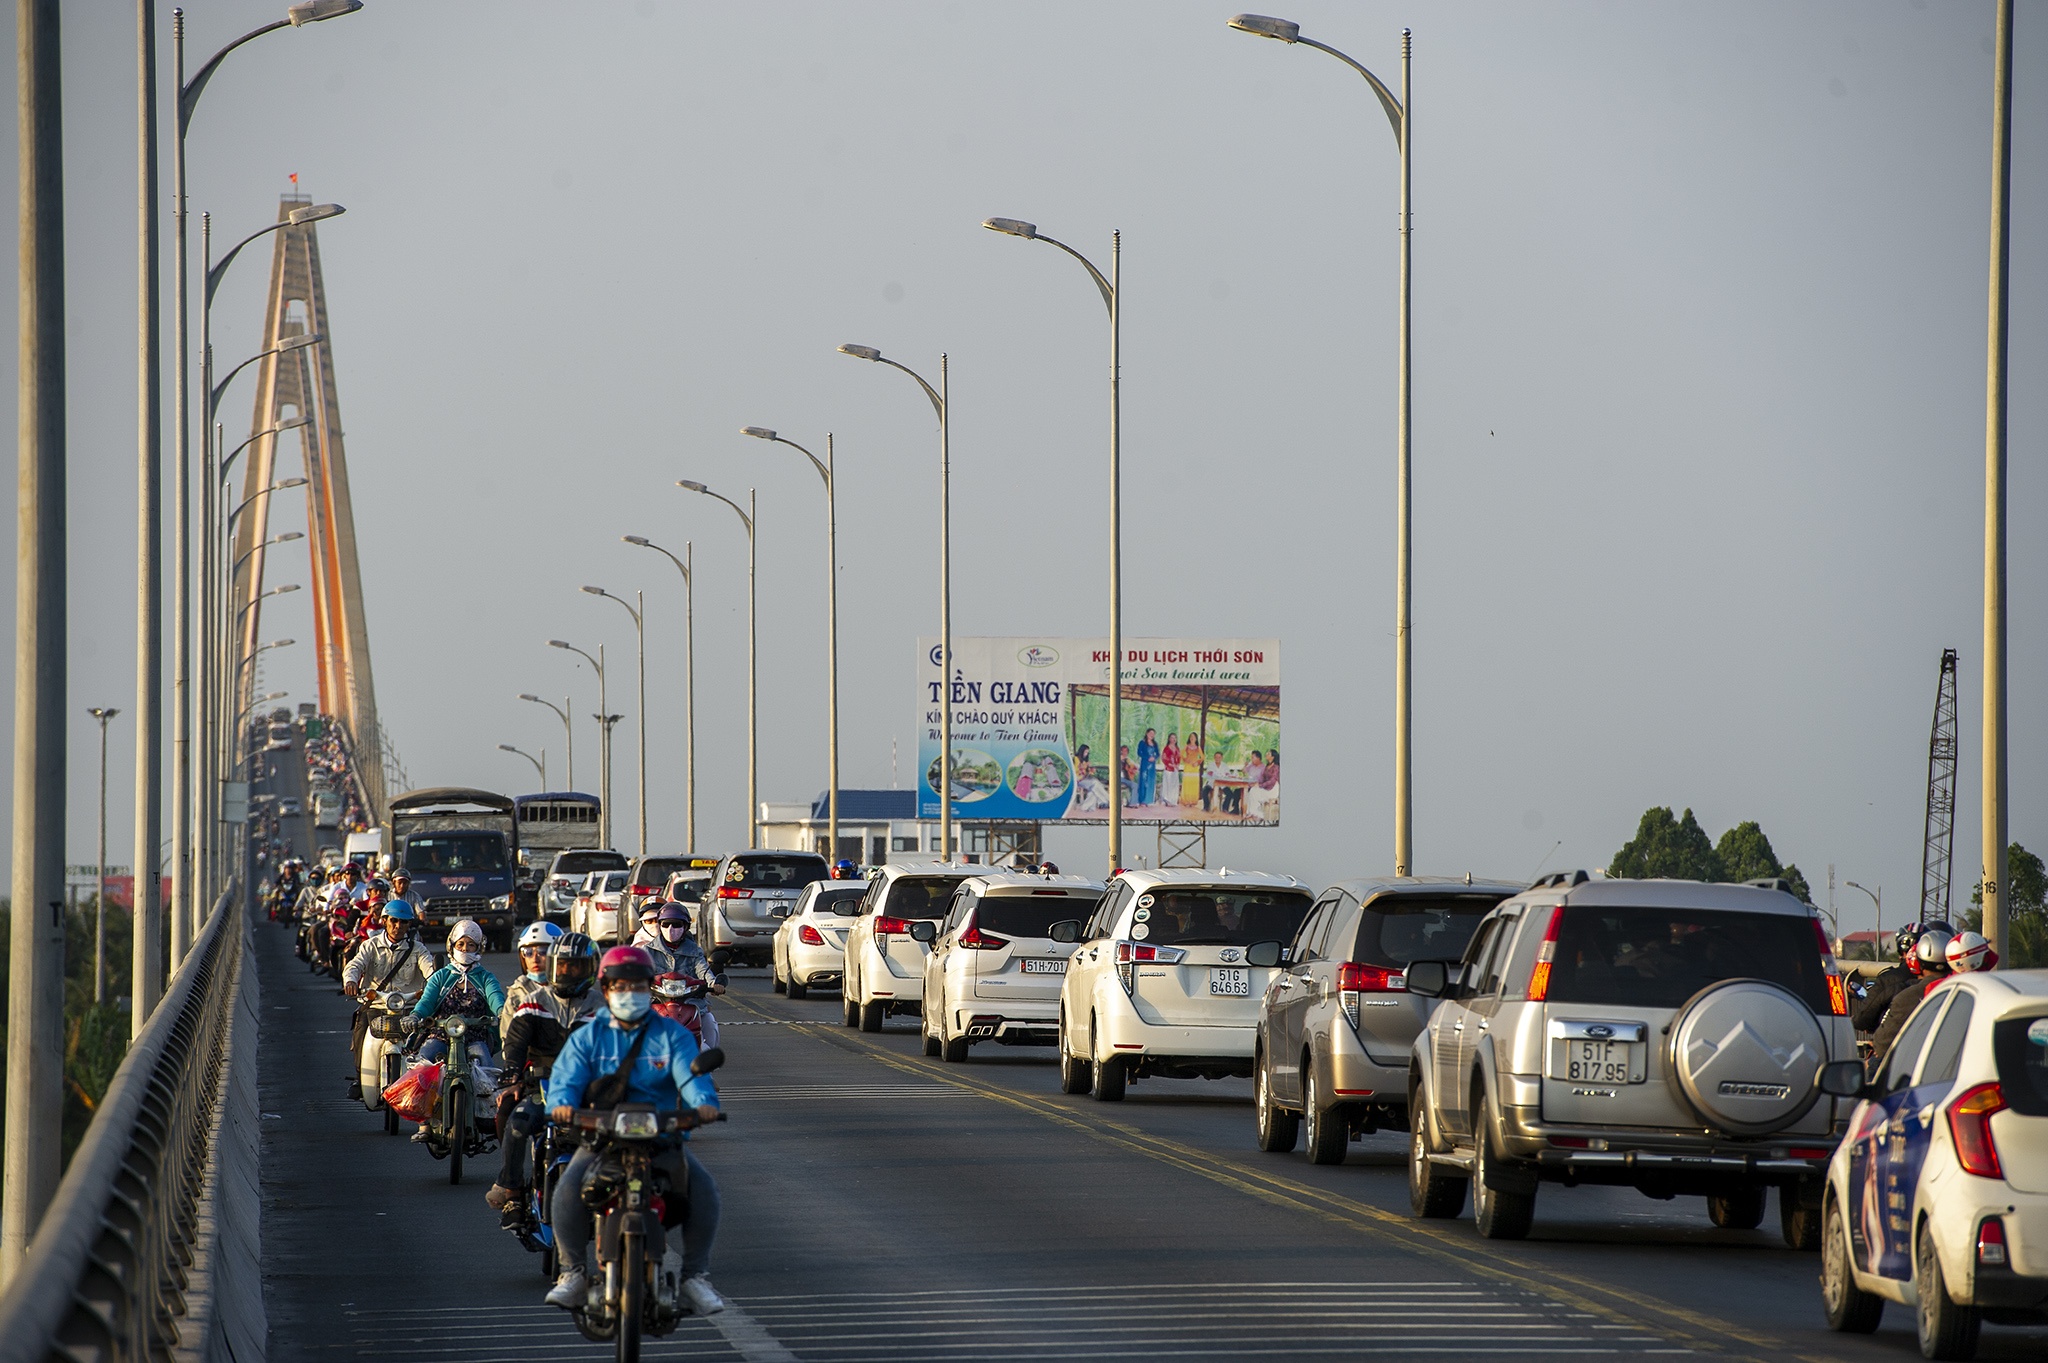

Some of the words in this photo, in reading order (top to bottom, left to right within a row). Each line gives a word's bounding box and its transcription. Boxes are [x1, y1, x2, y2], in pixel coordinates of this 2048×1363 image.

[1128, 650, 1148, 663] DU
[1154, 650, 1188, 666] LỊCH
[1194, 648, 1228, 663] THỚI
[1233, 649, 1264, 664] SƠN
[1141, 667, 1168, 680] Son
[1172, 668, 1216, 680] tourist
[1219, 671, 1251, 680] area
[928, 669, 982, 704] TỀN
[990, 681, 1061, 704] GIANG
[956, 709, 989, 725] CHÀO
[991, 709, 1015, 725] QUÝ
[1018, 709, 1058, 725] KHÁCH
[979, 730, 991, 741] to
[994, 729, 1020, 741] Tien
[1023, 729, 1059, 743] Giang
[1397, 865, 1405, 874] 17
[1984, 881, 1997, 894] 16
[1219, 969, 1240, 981] 51G
[1211, 981, 1248, 994] 646.63
[1583, 1043, 1614, 1061] 51F
[1570, 1061, 1626, 1081] 817.95
